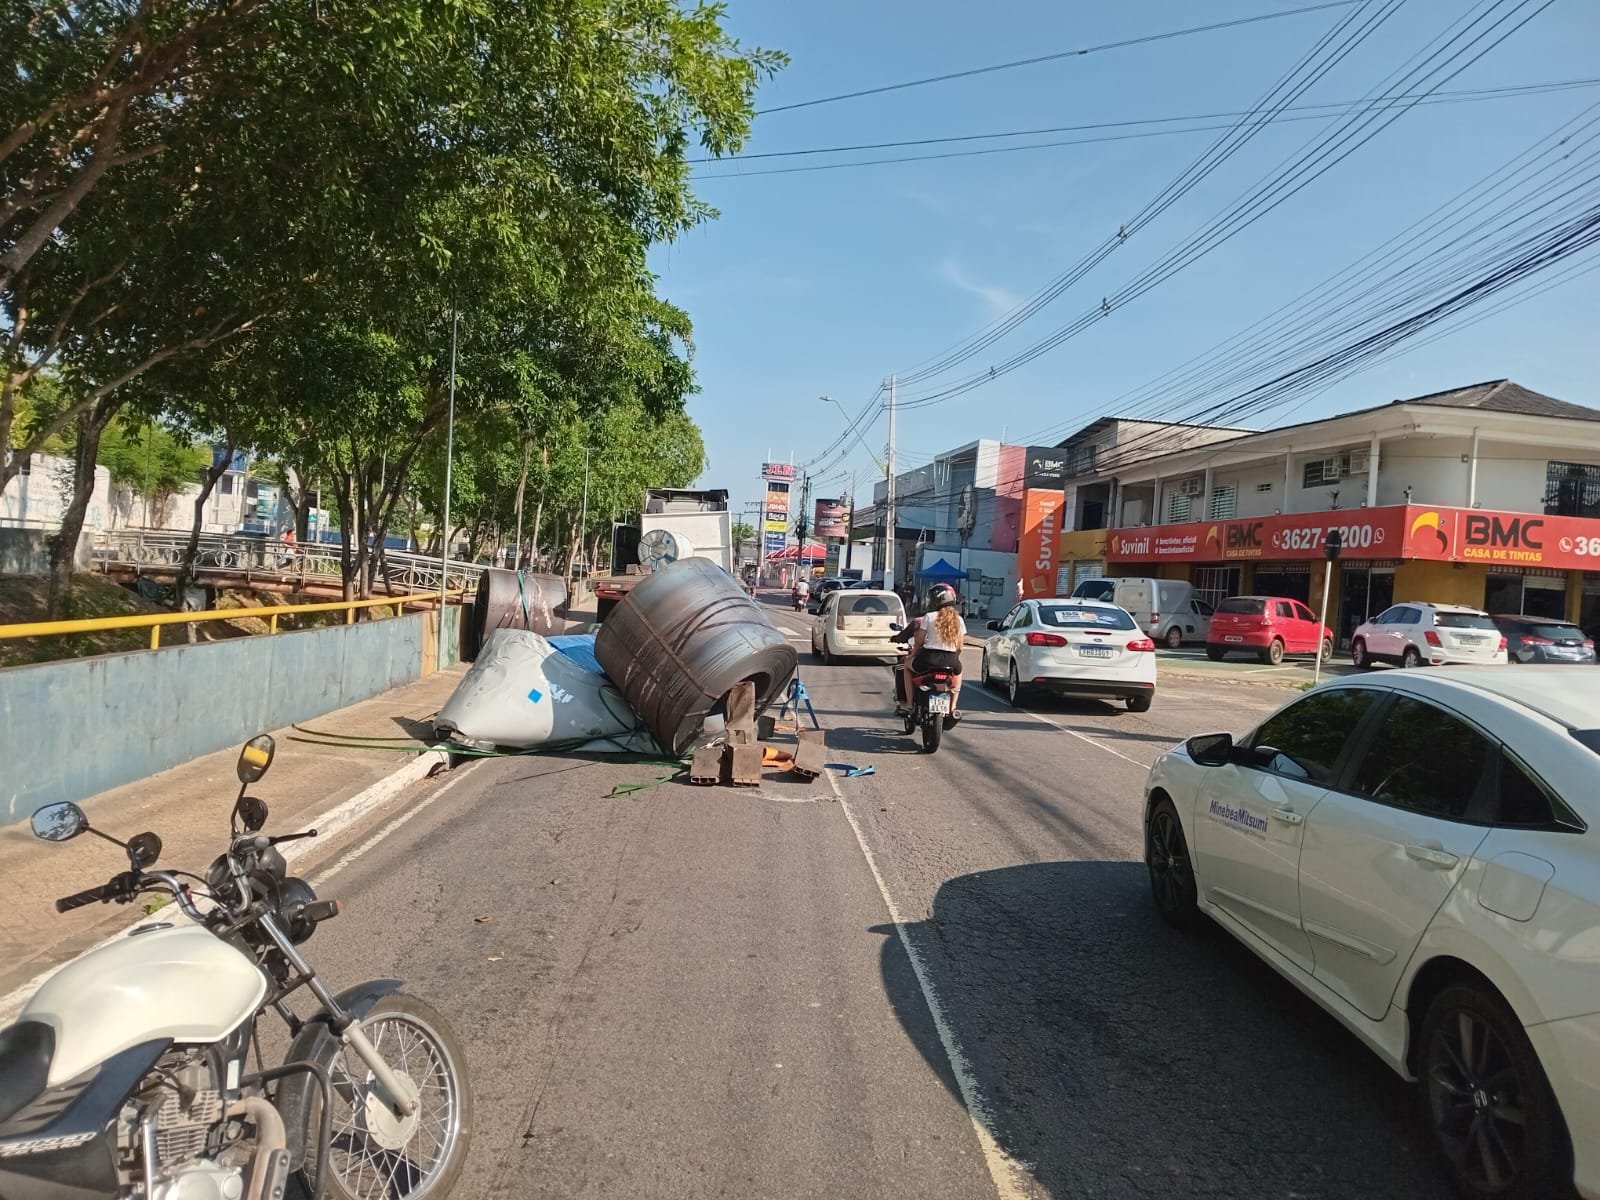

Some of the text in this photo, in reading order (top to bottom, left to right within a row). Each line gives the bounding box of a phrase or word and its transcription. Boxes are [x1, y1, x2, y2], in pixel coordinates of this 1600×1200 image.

[1035, 501, 1055, 571] Suvinil
[1227, 521, 1264, 548] BMC
[1281, 524, 1372, 550] 3627-200
[1465, 515, 1544, 549] BMC
[1120, 537, 1150, 555] Suvinil
[1239, 549, 1246, 557] DE
[1246, 548, 1262, 557] TINTAS
[1464, 547, 1543, 562] CASA DE TINTAS
[1208, 799, 1269, 833] MinebeaMitsumi
